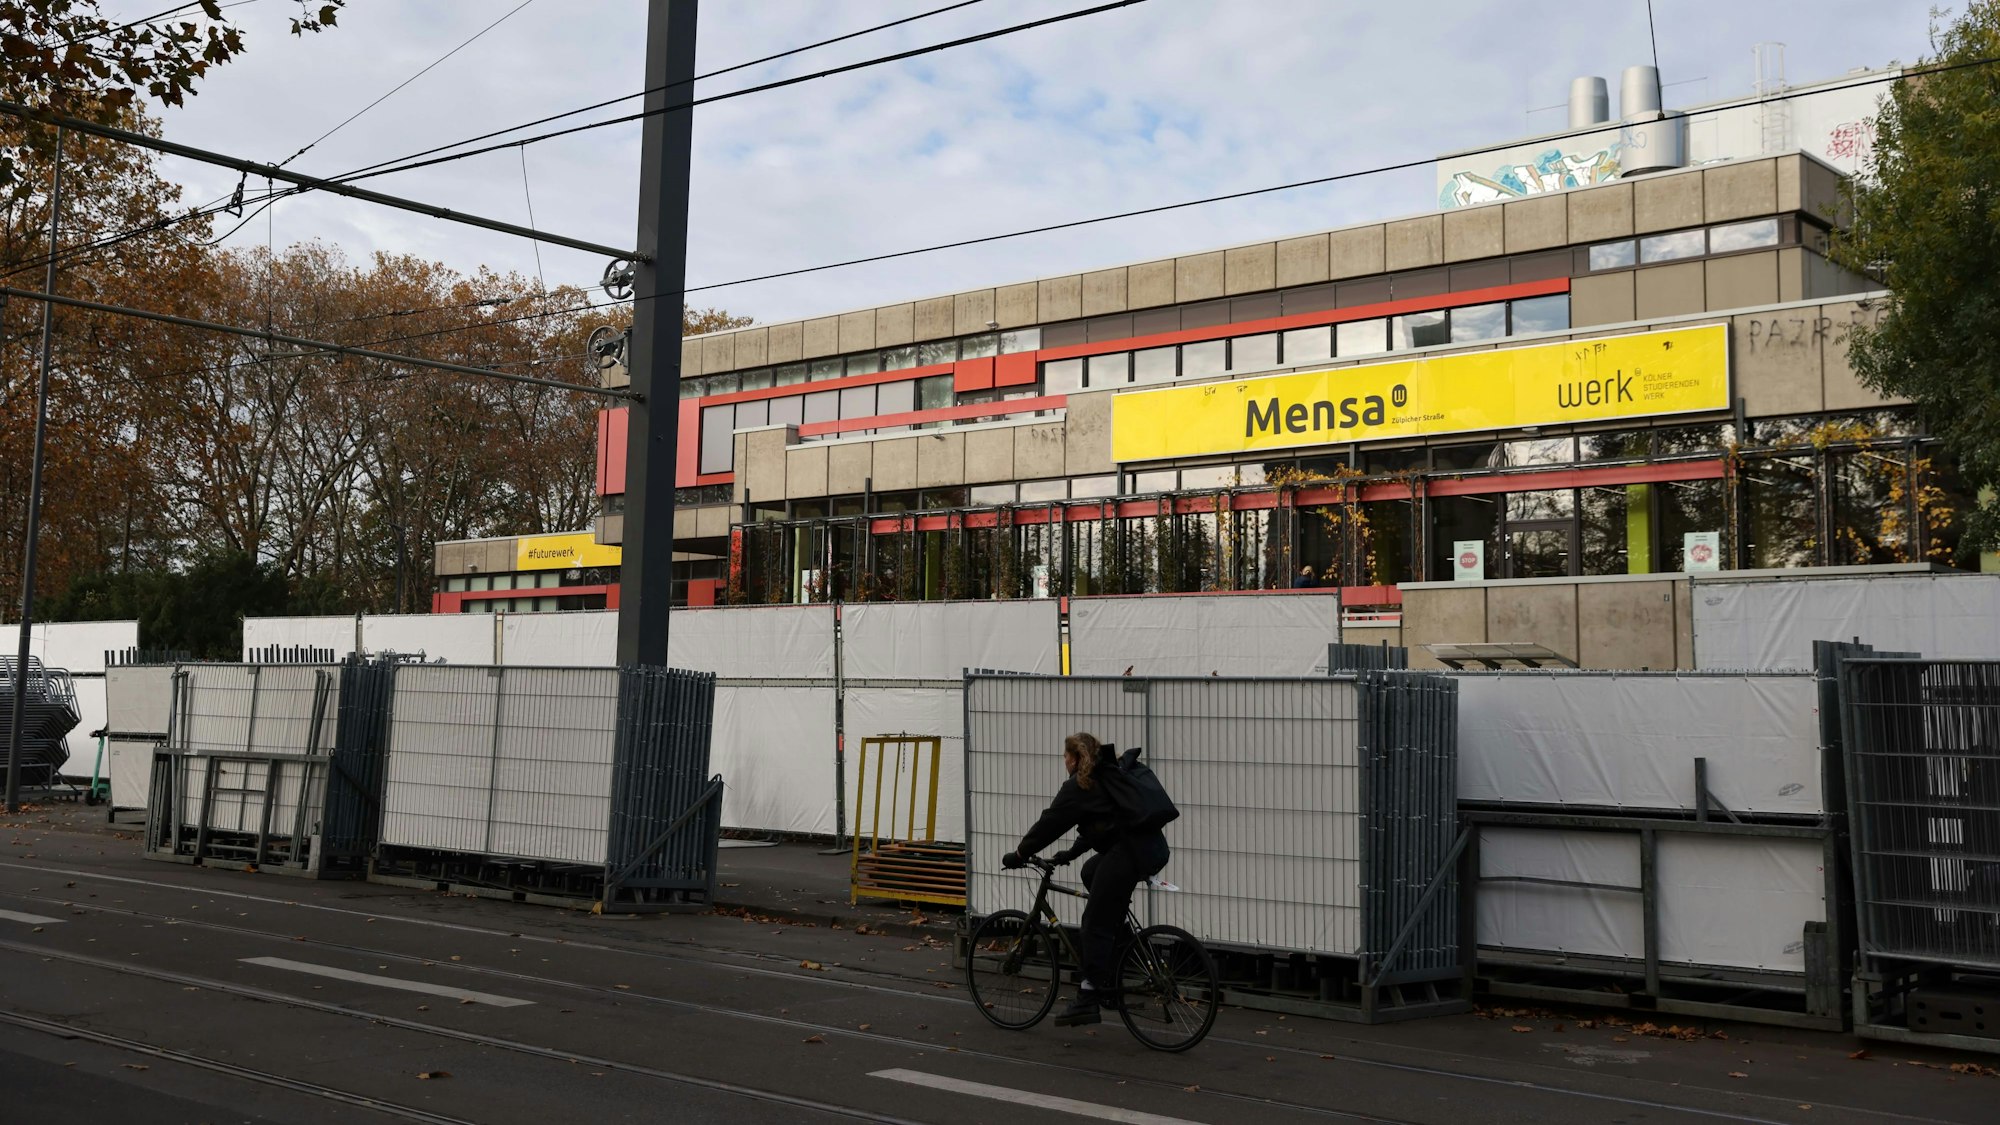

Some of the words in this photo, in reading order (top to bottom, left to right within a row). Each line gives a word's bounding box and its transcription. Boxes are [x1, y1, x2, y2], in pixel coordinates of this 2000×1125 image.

[1643, 372, 1672, 382] KÖLNER
[1558, 369, 1633, 409] werk
[1643, 379, 1700, 392] STUDIERENDEN
[1643, 391, 1665, 401] WERK
[1246, 395, 1385, 437] Mensa
[1391, 416, 1421, 424] Zülpicher
[1423, 413, 1445, 421] Straße
[528, 546, 575, 560] #futurewerk
